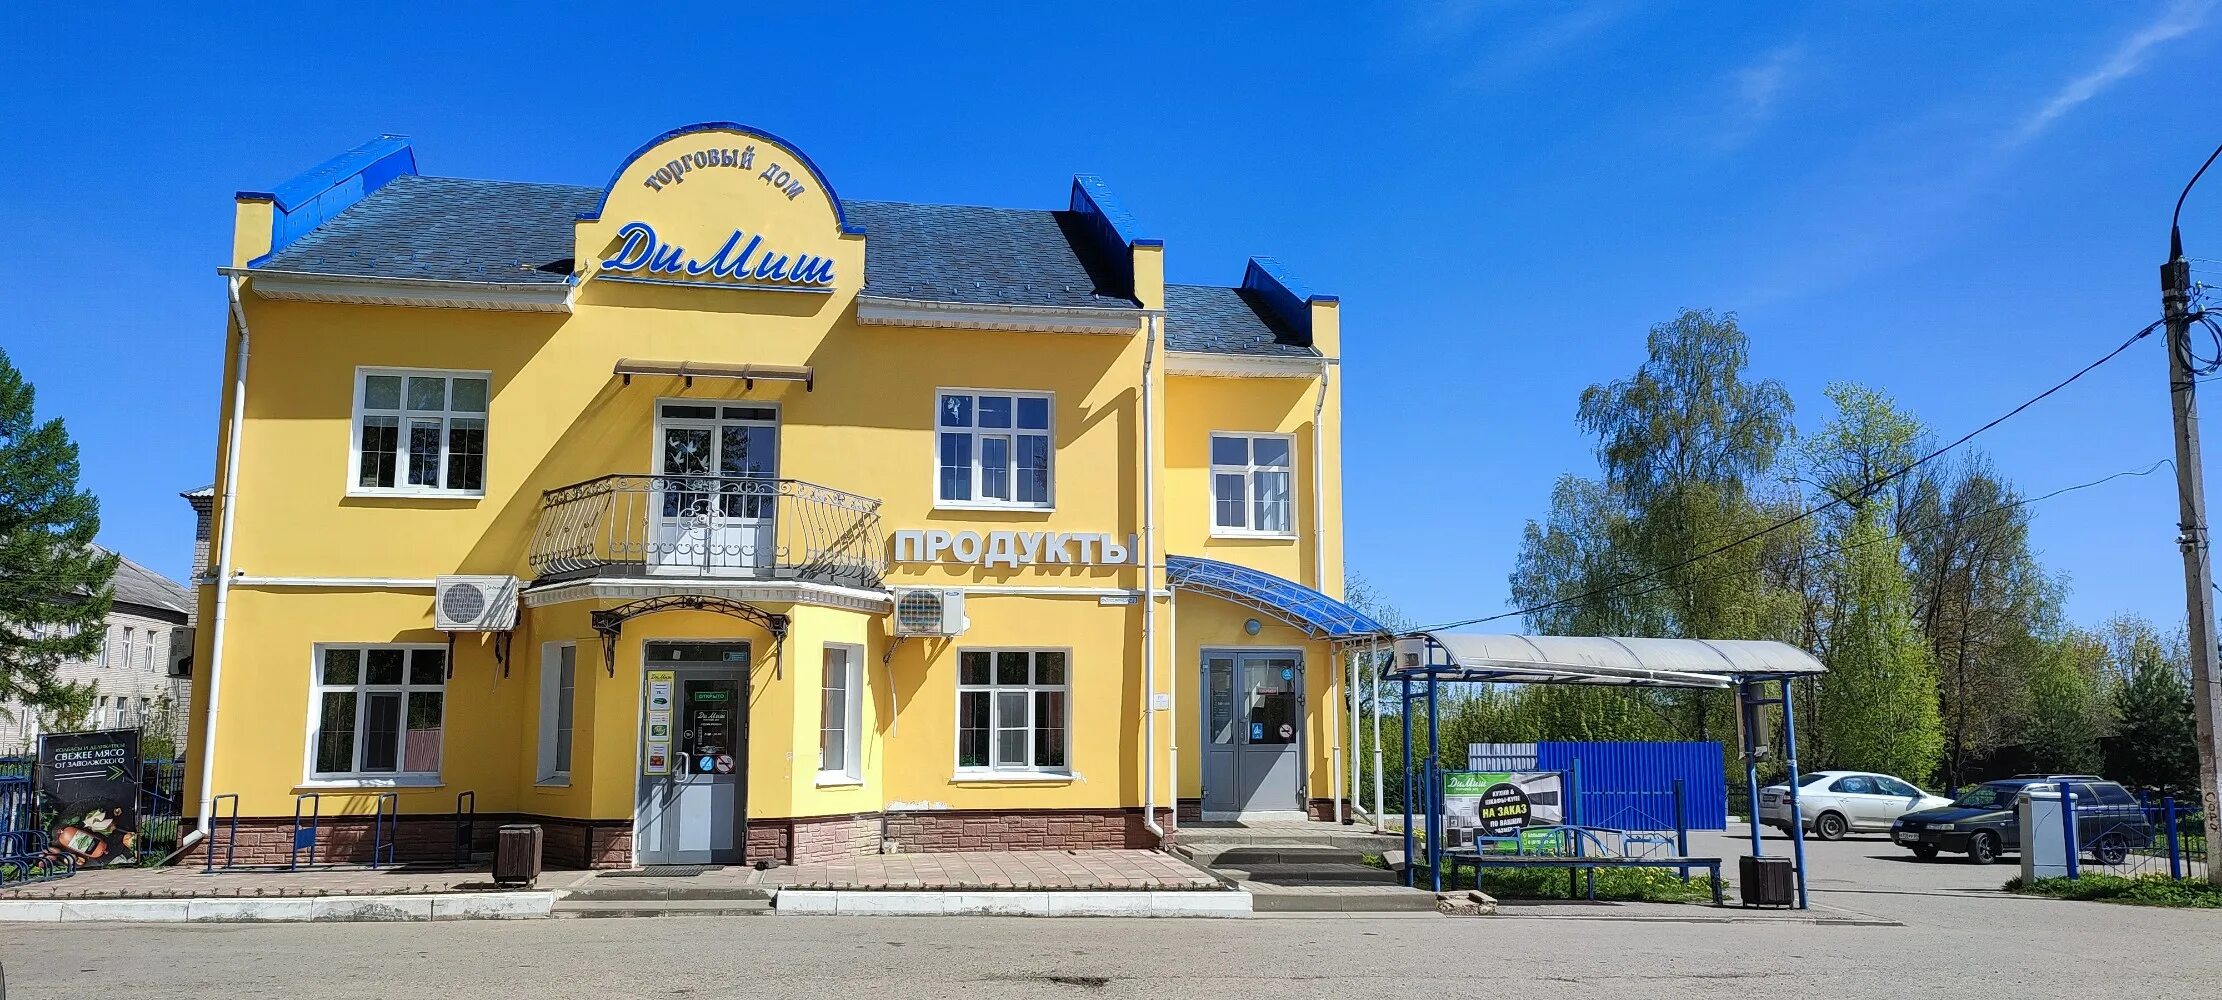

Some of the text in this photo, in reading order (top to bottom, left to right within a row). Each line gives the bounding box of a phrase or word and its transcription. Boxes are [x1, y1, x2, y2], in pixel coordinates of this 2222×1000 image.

[643, 145, 806, 202] торговый дом
[894, 529, 1139, 569] ПРОДУКТЫ
[54, 748, 125, 762] СВЕЖЕЕ МЯСО
[54, 757, 125, 769] ОТ ЗАВОЛЖСКОГО
[1482, 803, 1528, 819] НА ЗАКАЗ
[1490, 820, 1499, 828] ПО
